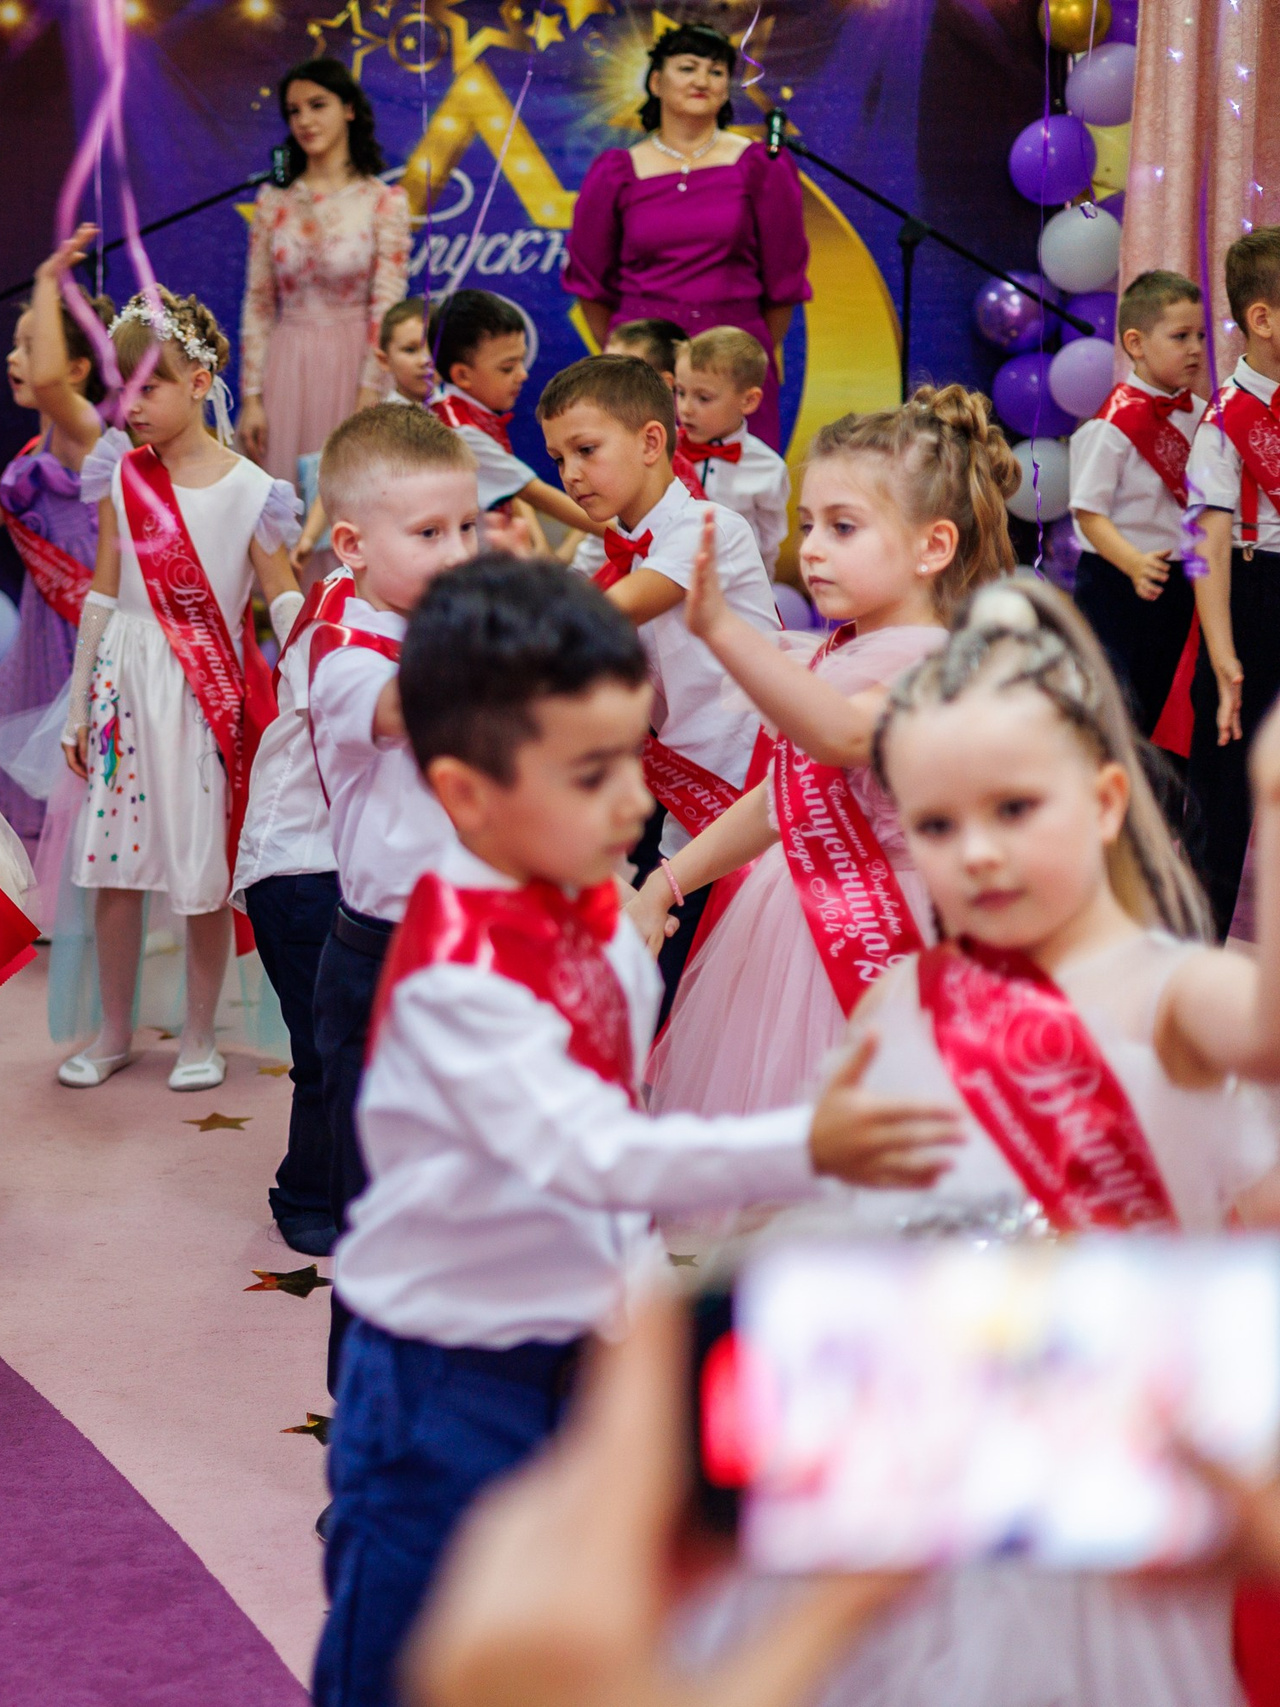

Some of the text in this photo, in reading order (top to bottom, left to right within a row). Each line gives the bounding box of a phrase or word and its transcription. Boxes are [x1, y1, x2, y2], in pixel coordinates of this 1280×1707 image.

[165, 554, 241, 722] Выпускница
[776, 738, 847, 935] детского сада №4
[791, 740, 890, 959] Выпускница
[828, 777, 869, 859] Самохина
[866, 857, 903, 936] Варвара
